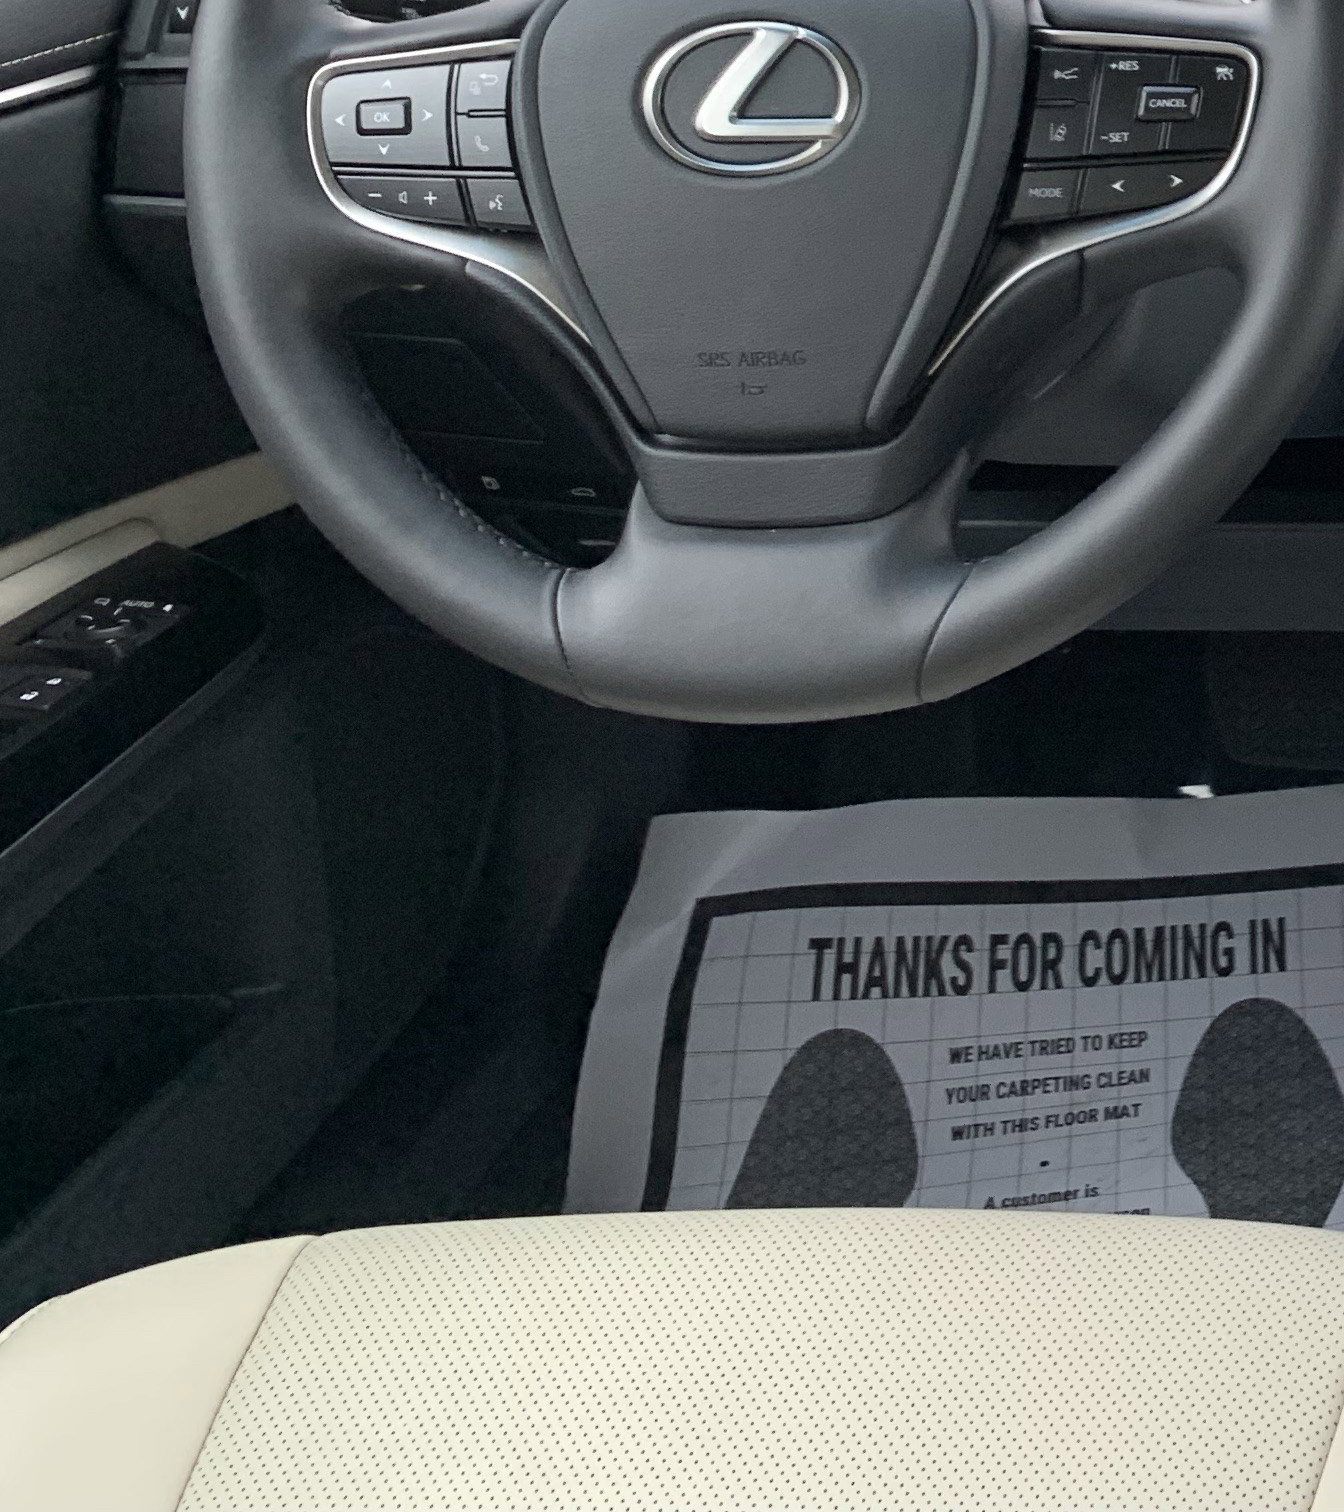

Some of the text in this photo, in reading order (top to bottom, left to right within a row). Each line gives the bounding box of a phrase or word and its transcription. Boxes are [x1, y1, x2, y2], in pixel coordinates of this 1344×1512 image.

[1149, 98, 1188, 108] CANCEL
[373, 111, 391, 123] OK
[1028, 187, 1064, 199] MODE
[697, 349, 807, 368] SRS AIRBAG
[119, 599, 155, 608] AUTO
[807, 916, 1288, 1002] THANKS FOR COMING IN
[948, 1030, 1149, 1065] WE HAVE TRIED TO KEEP
[945, 1067, 1151, 1106] YOUR CARPETING CLEAN
[951, 1102, 1143, 1142] WITH THIS FLOOR MAT
[984, 1183, 1100, 1209] A customer is
